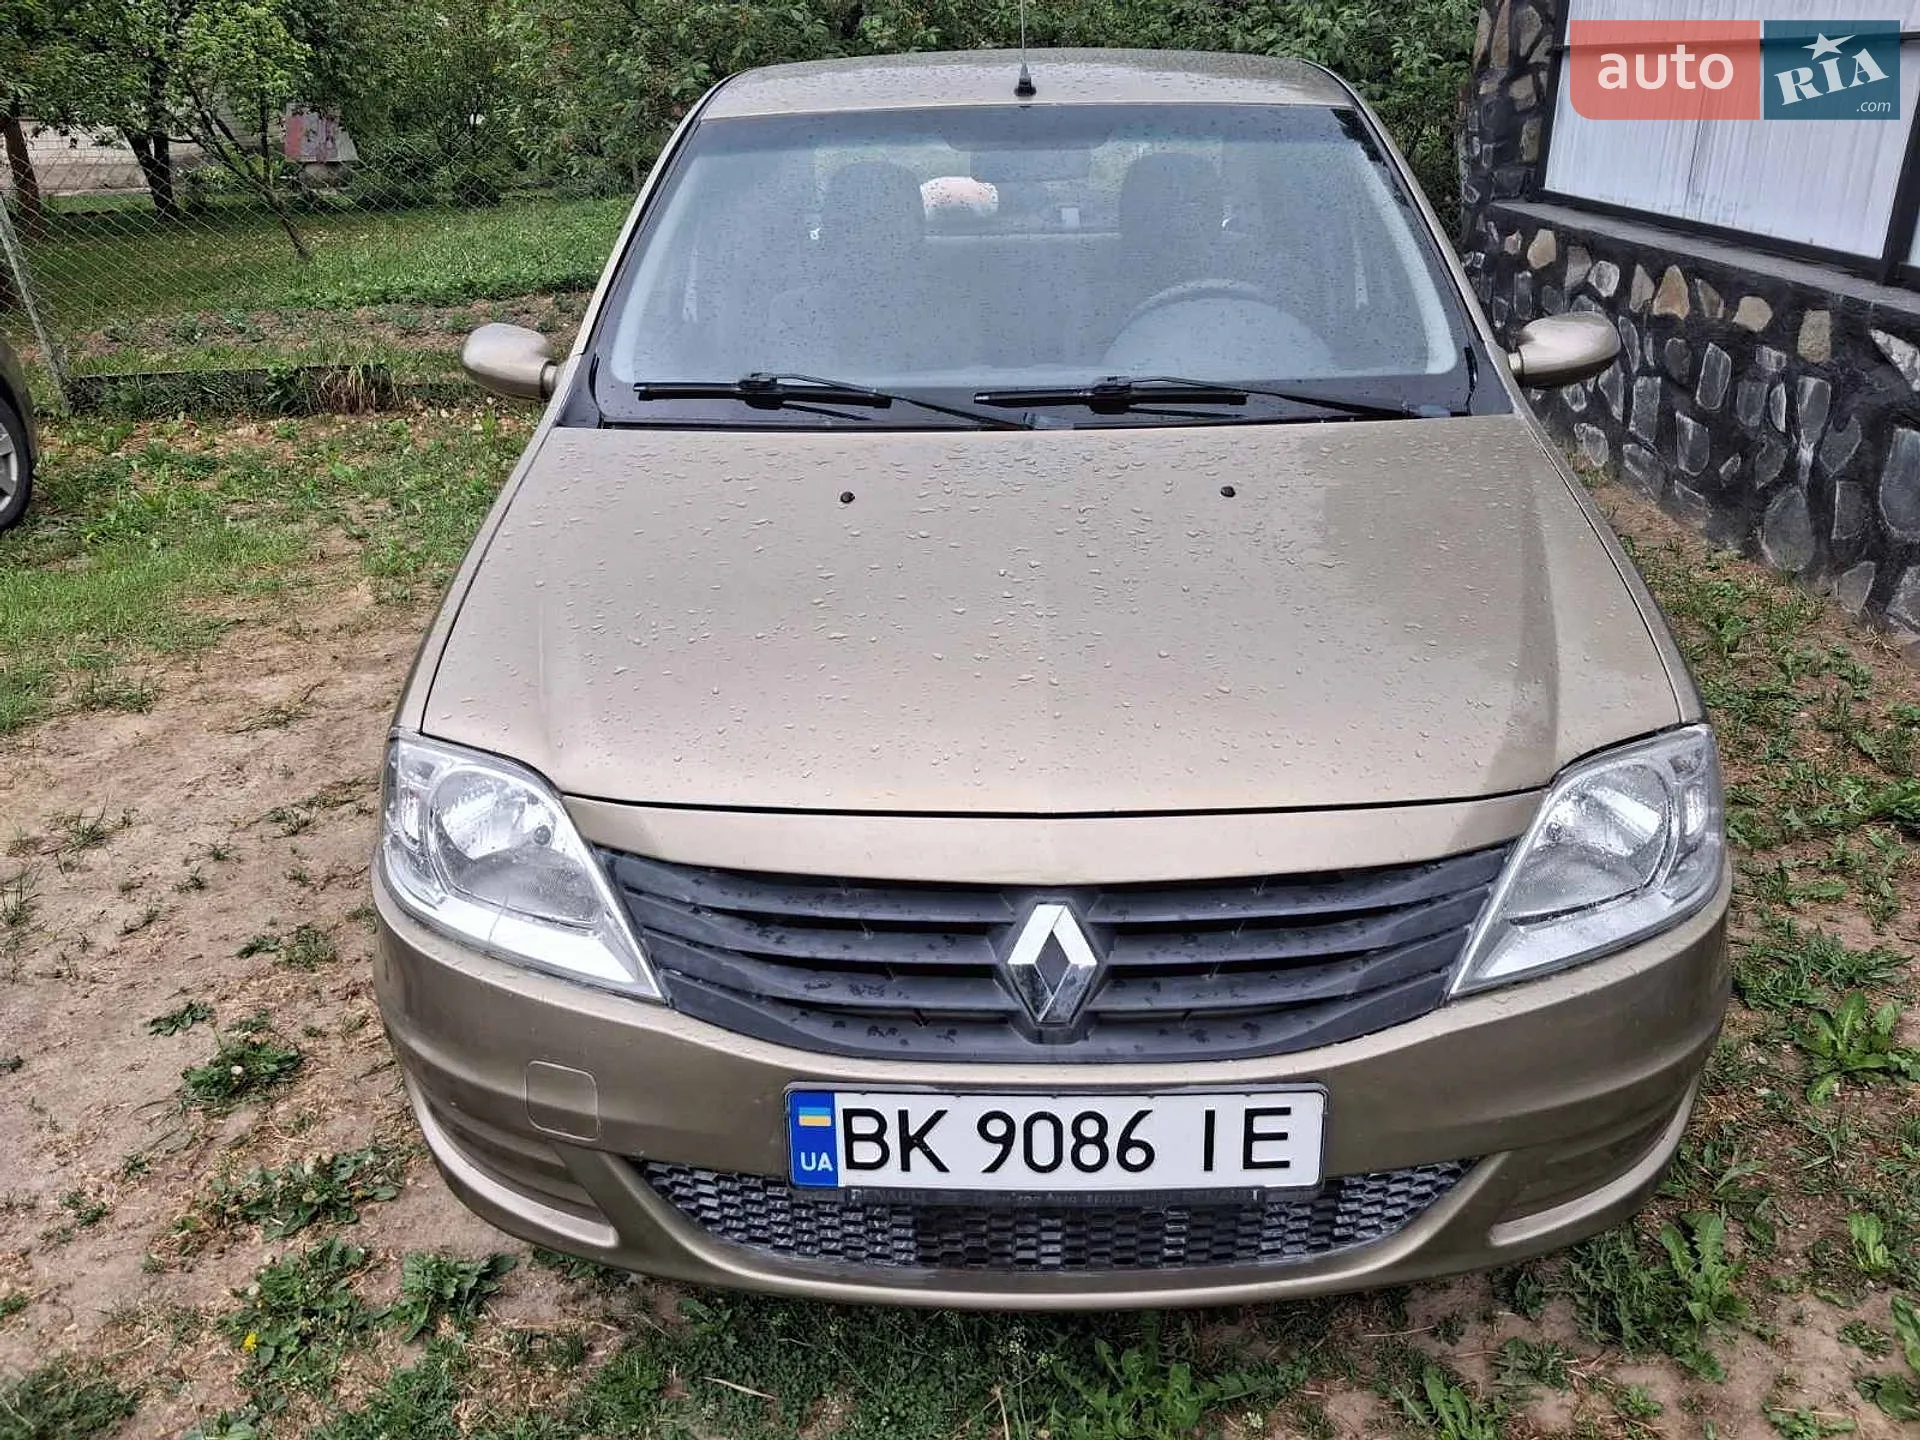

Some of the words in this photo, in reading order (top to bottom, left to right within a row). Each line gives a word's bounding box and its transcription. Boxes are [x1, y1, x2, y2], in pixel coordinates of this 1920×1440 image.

[800, 1151, 833, 1171] UA
[842, 1108, 950, 1173] BK
[976, 1109, 1156, 1174] 9086
[1203, 1106, 1292, 1172] IE
